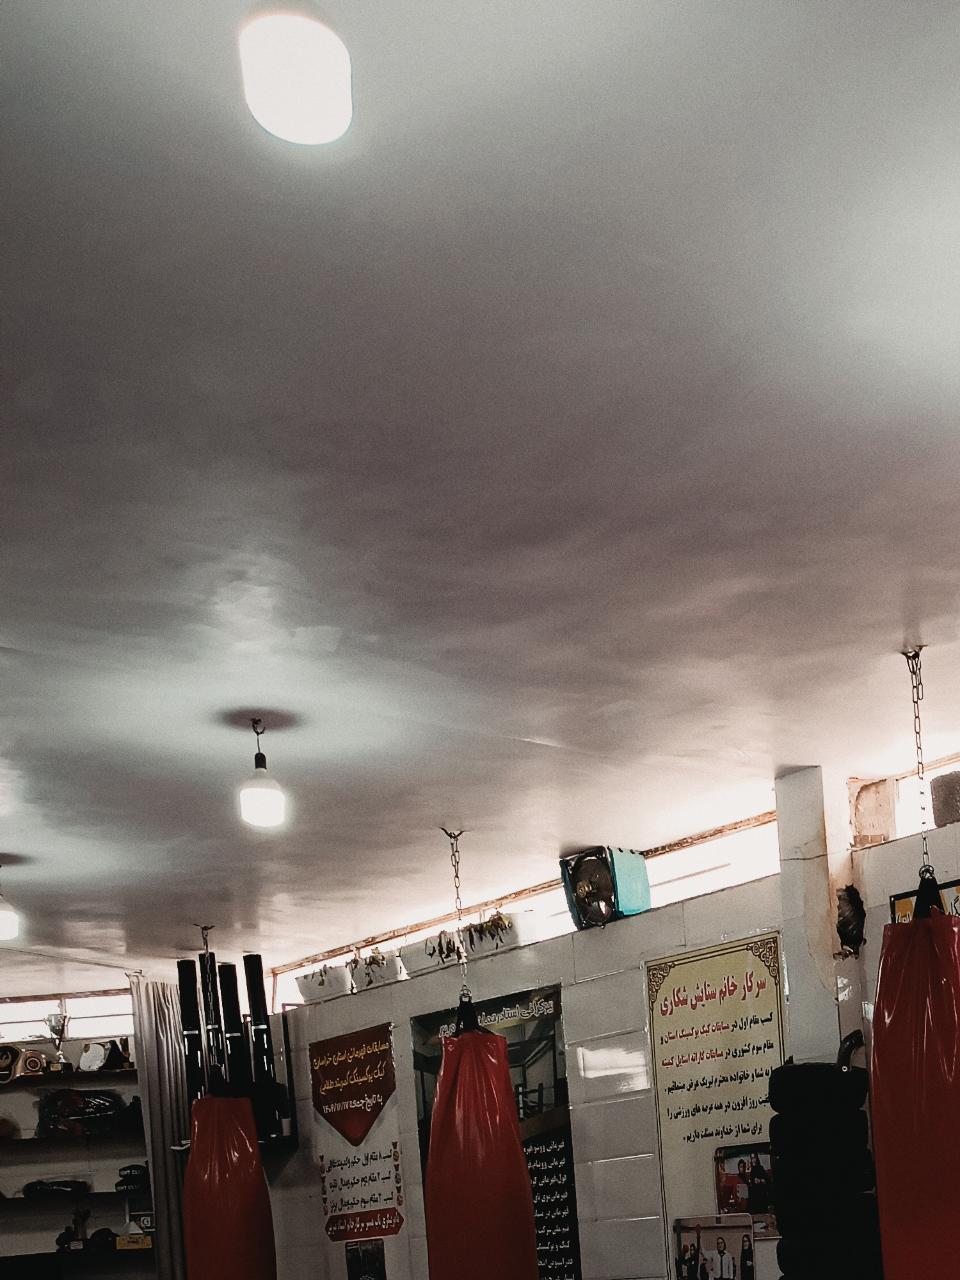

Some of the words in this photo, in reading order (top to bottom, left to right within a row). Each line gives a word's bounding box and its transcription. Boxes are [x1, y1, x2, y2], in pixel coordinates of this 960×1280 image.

[660, 985, 688, 1016] شکاری
[690, 980, 716, 1010] ستایش
[718, 975, 738, 1006] خانم
[730, 1020, 738, 1033] در
[738, 1017, 748, 1031] اول
